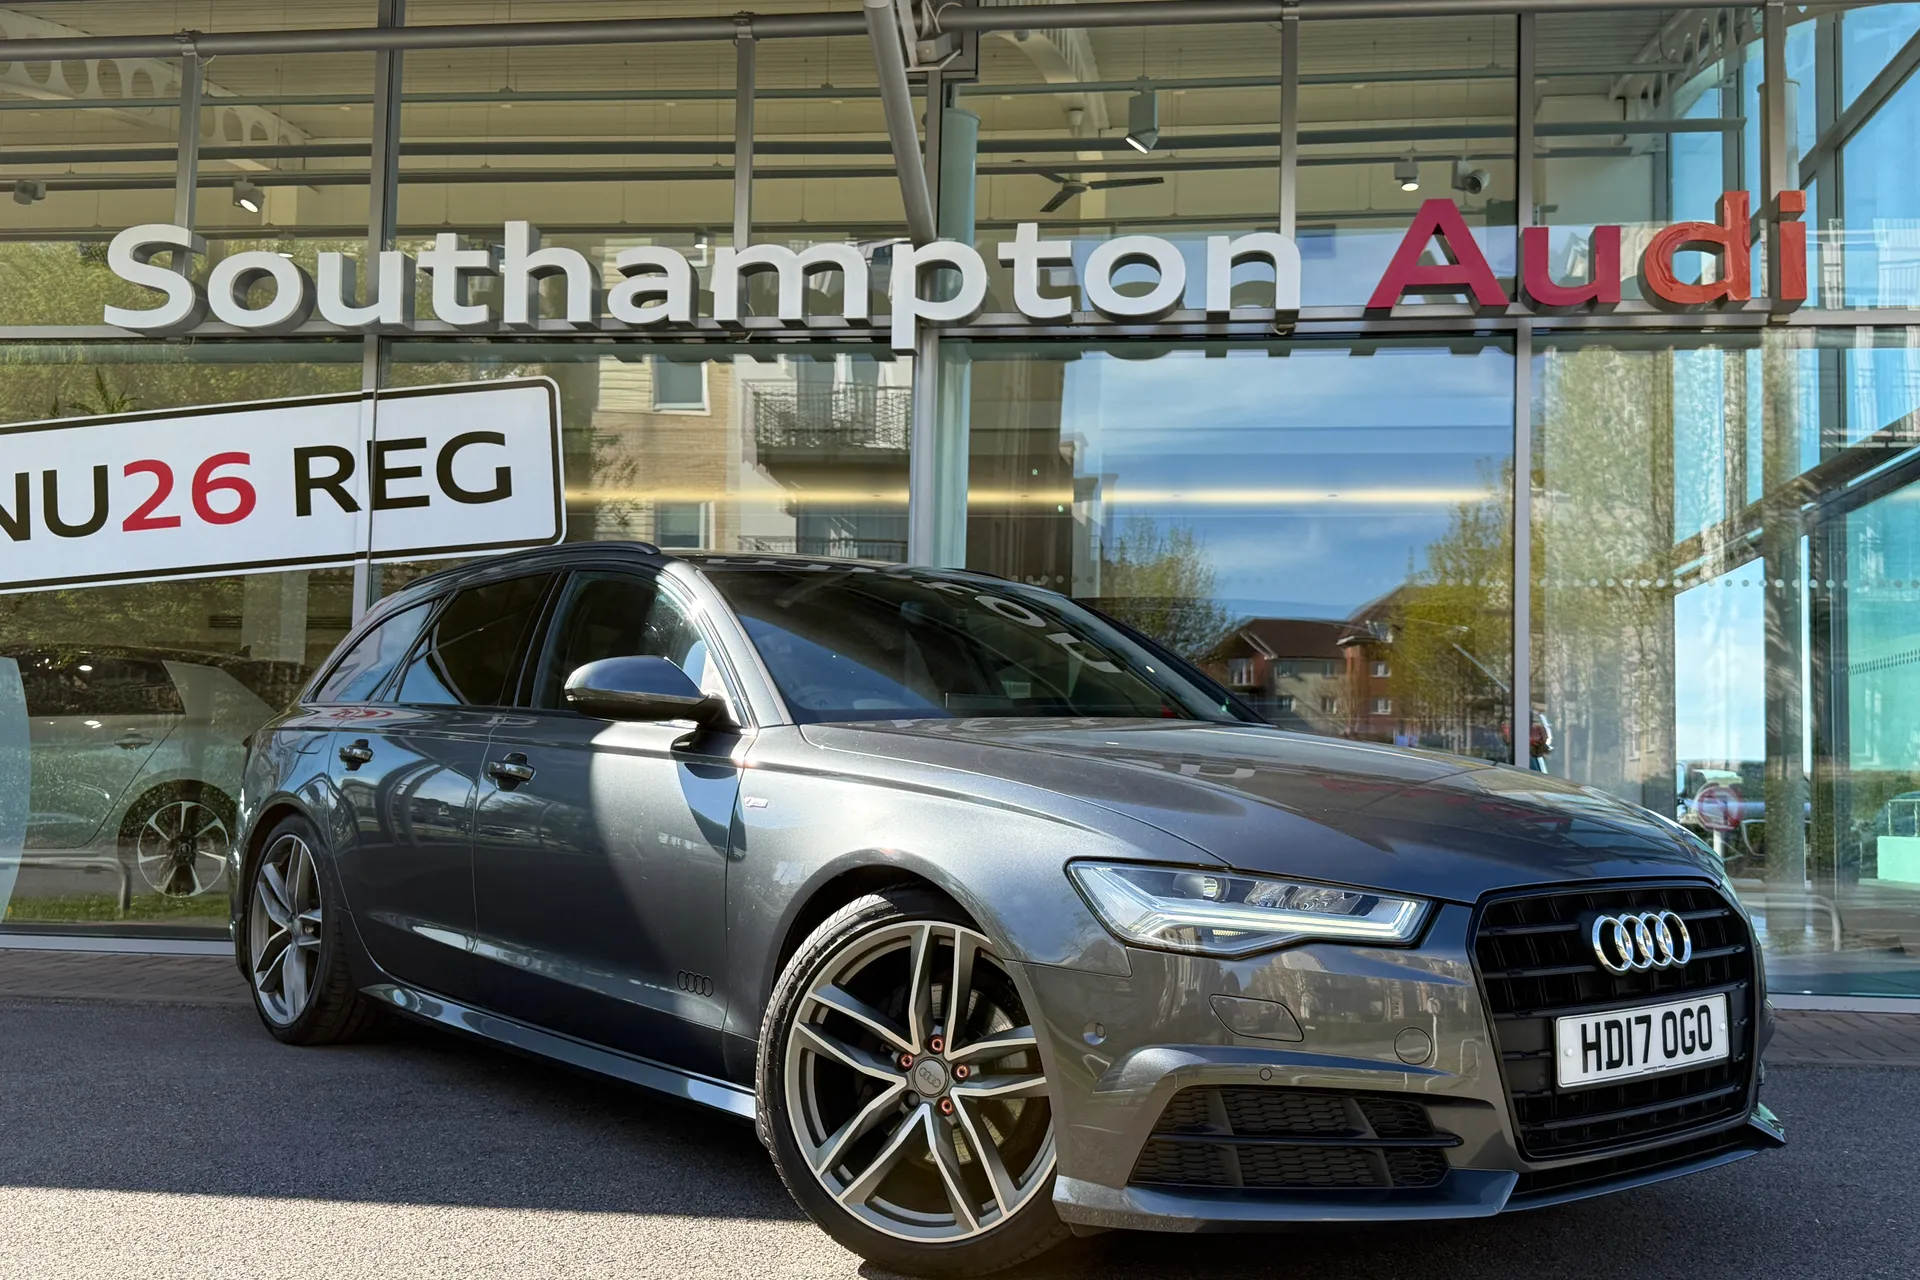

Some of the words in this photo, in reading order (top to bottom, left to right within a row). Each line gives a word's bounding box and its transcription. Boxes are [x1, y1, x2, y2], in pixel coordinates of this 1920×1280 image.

[103, 220, 1301, 353] Southampton
[1365, 190, 1808, 317] Audi
[293, 431, 513, 518] REG
[1580, 1013, 1652, 1074] HD17
[1661, 1004, 1713, 1059] OGO
